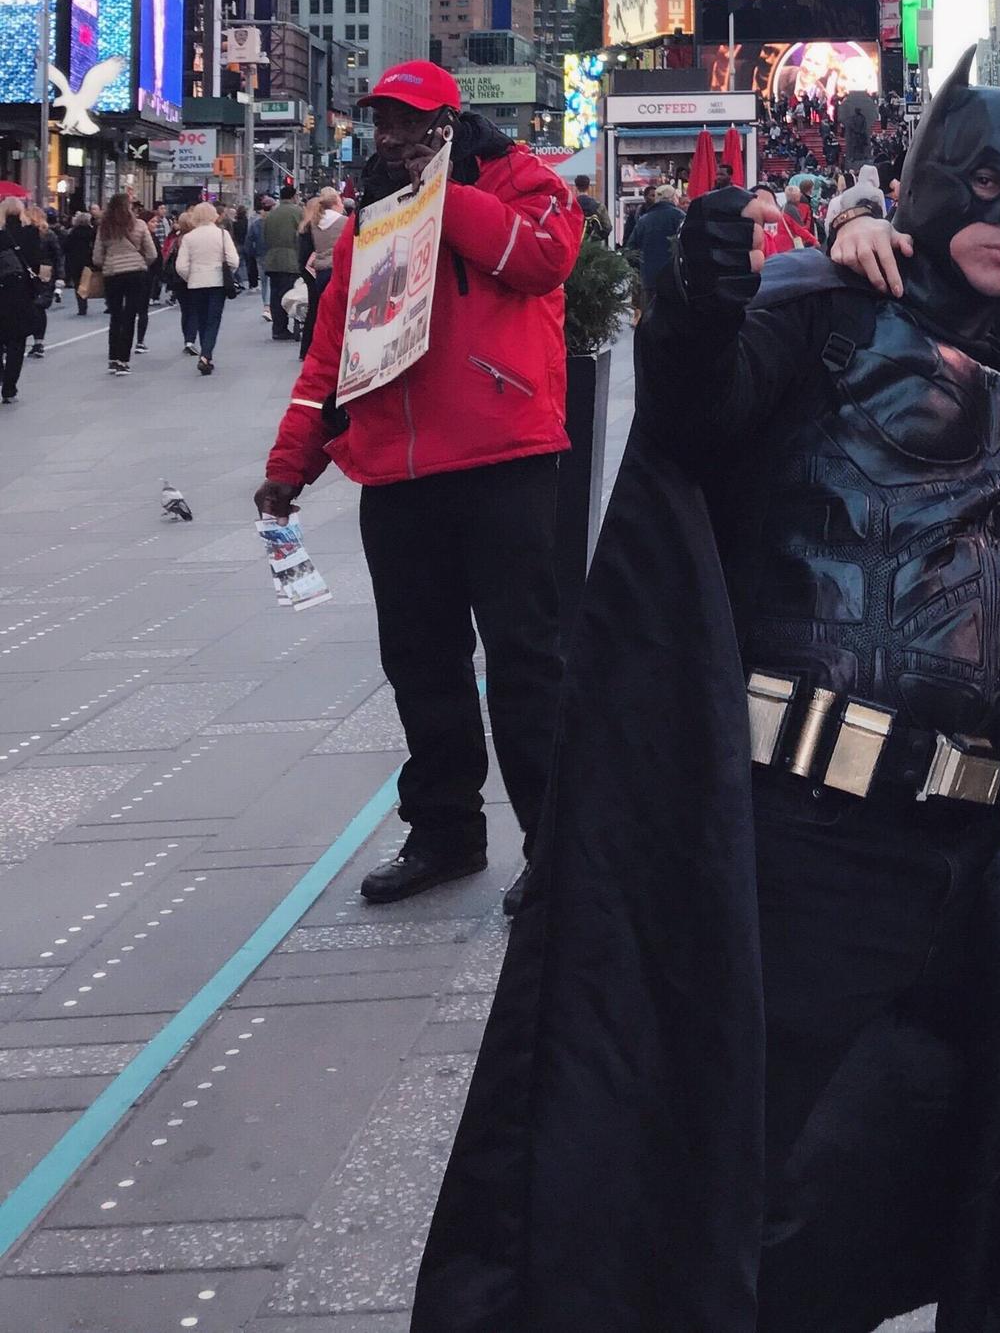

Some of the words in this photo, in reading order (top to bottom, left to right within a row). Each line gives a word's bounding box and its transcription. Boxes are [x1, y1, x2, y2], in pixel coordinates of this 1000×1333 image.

[478, 84, 500, 92] DOING
[478, 91, 504, 99] THERE?
[638, 102, 697, 114] COFFEED
[535, 146, 575, 155] HOTDOGS
